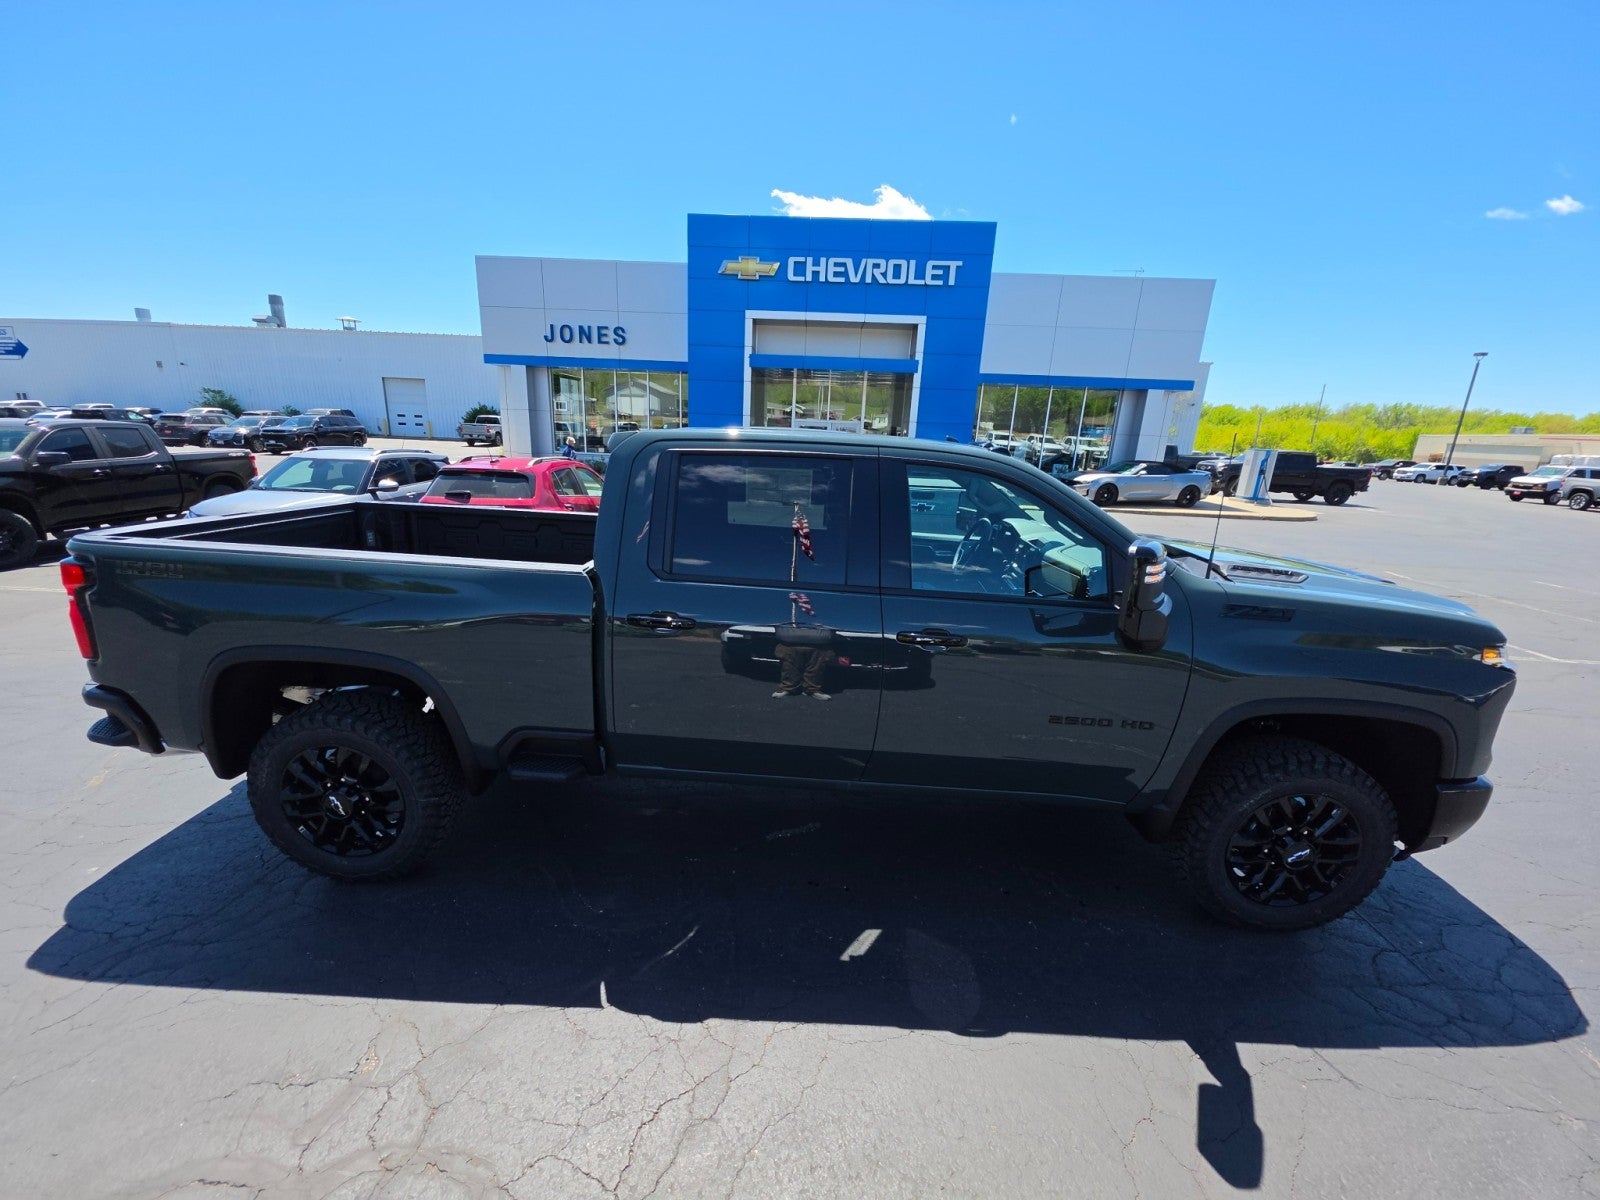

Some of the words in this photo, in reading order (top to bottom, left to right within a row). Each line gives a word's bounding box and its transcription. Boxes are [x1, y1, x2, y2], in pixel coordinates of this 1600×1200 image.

[787, 256, 963, 286] CHEVROLET
[543, 323, 627, 346] JONES
[1048, 715, 1114, 728] 2500
[1120, 720, 1155, 731] HD
